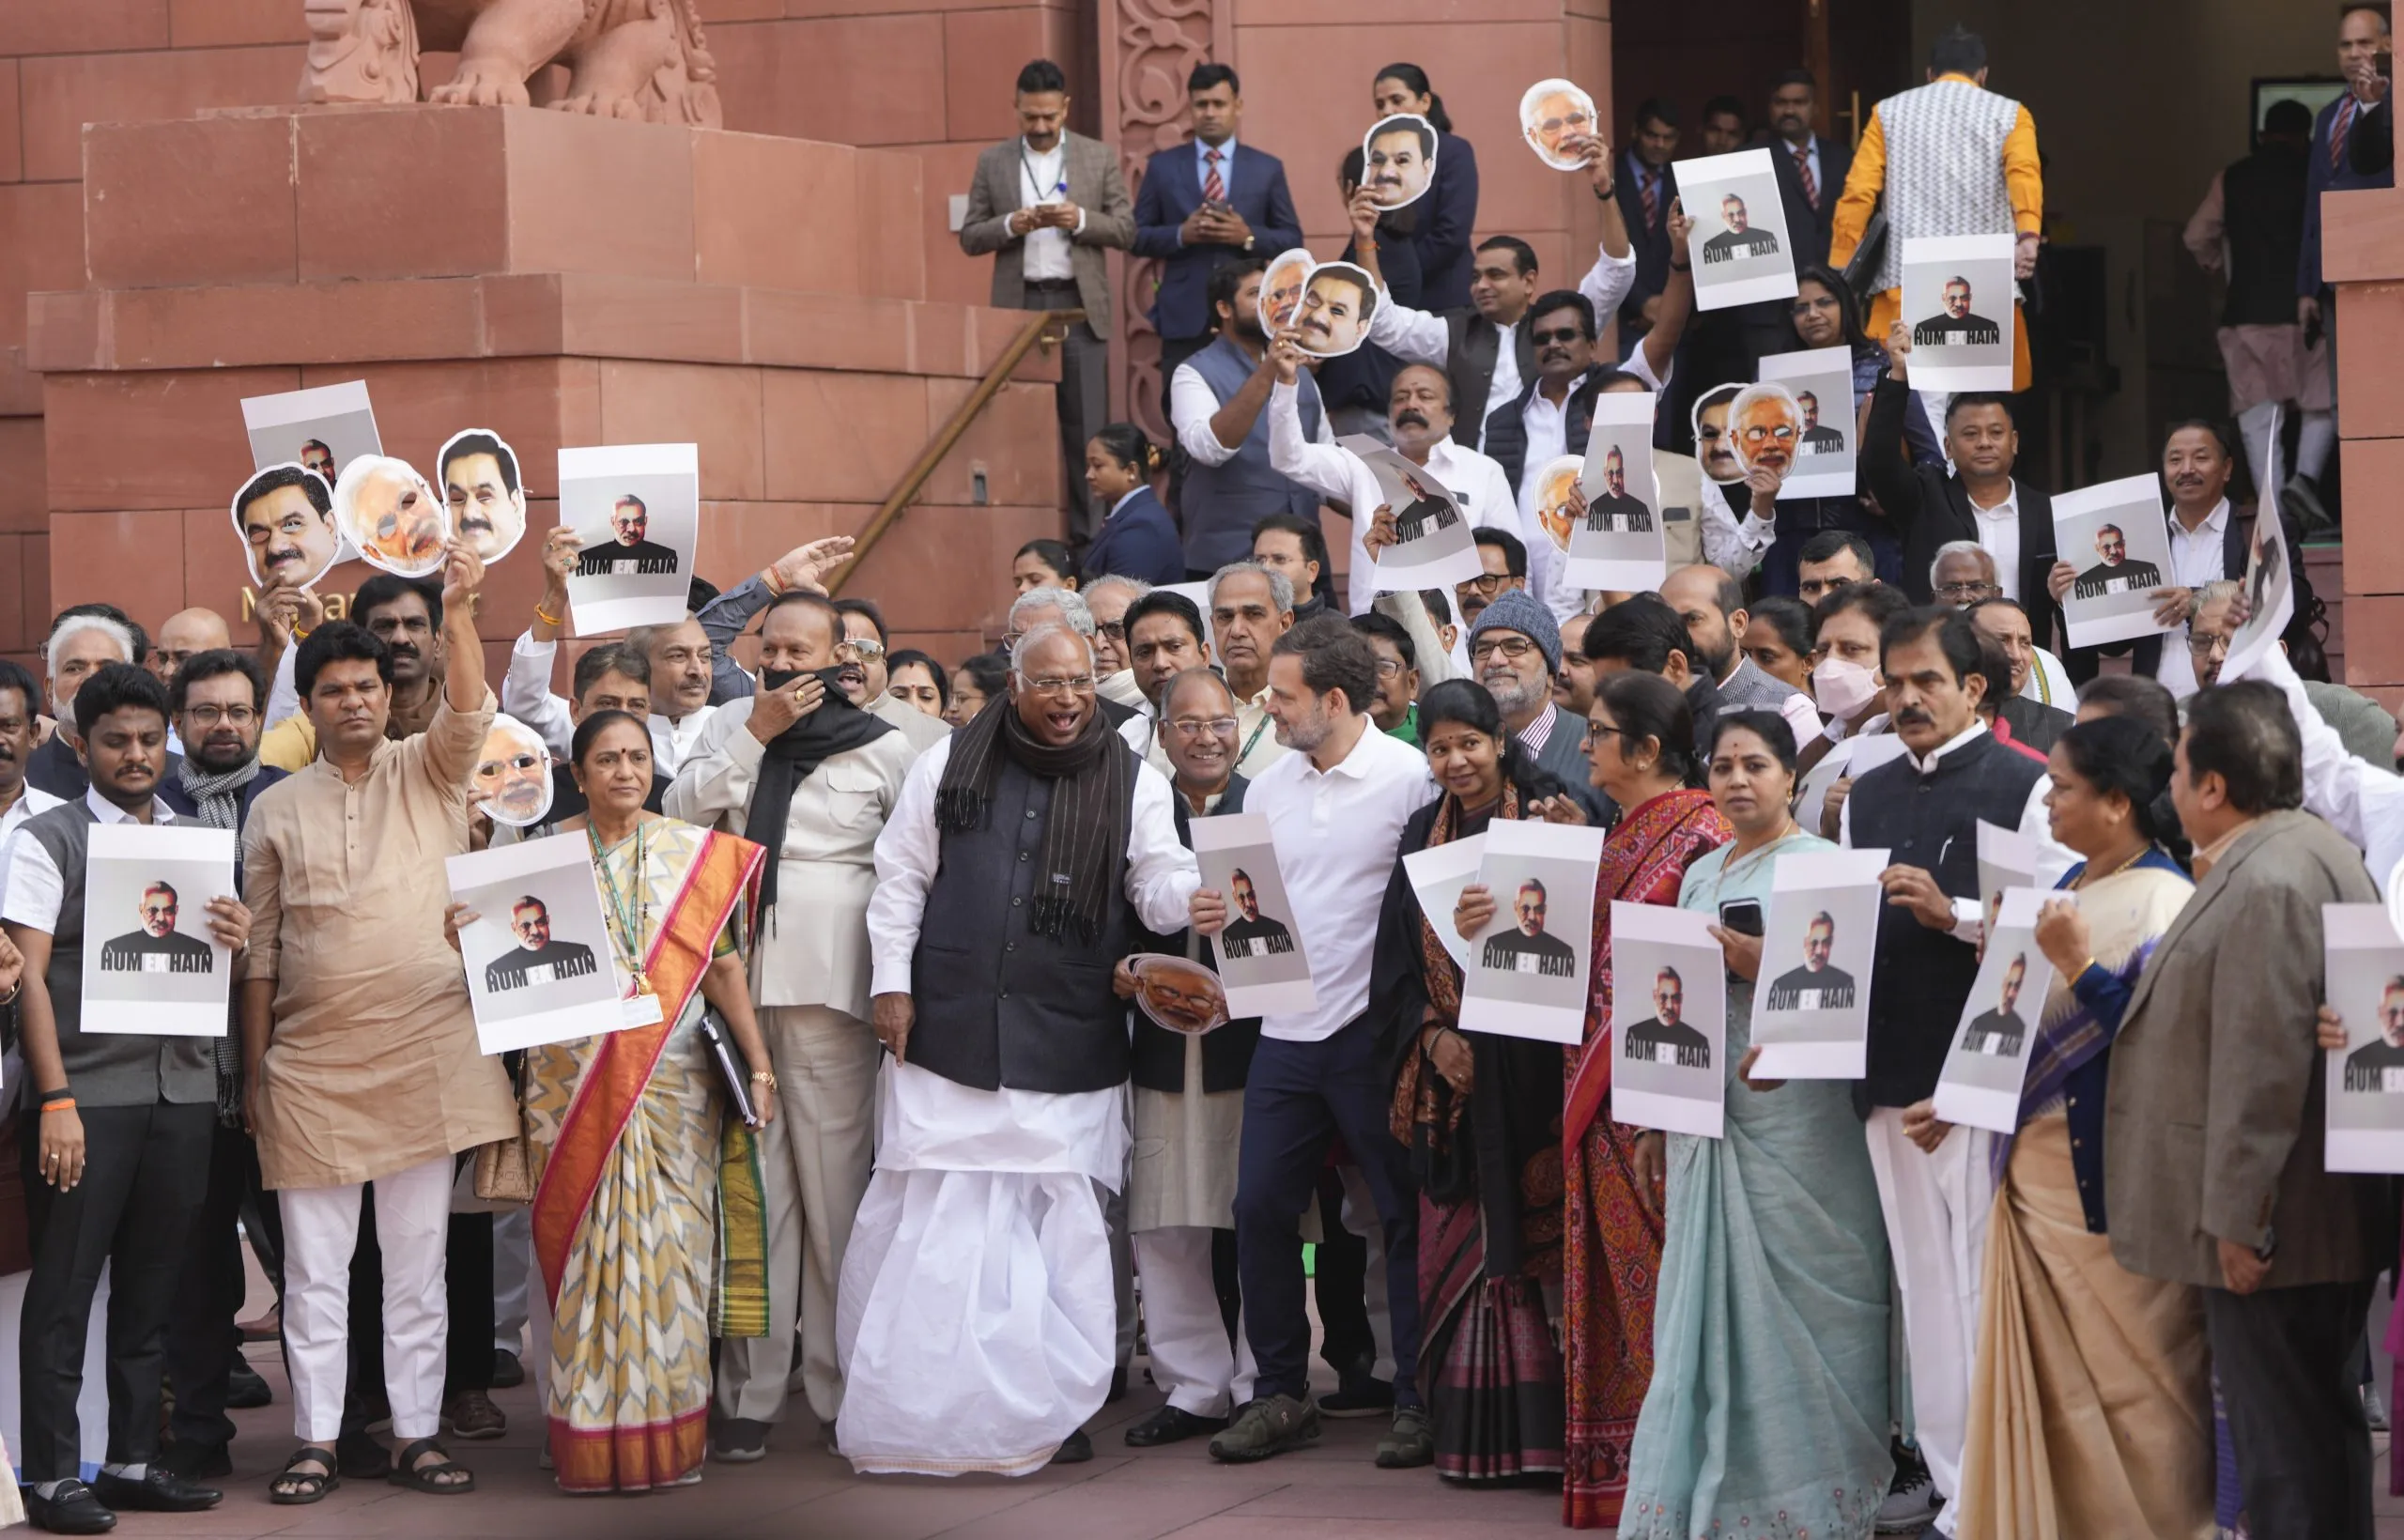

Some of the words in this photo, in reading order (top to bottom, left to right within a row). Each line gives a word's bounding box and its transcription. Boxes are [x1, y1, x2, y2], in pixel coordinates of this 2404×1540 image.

[1703, 246, 1733, 265] HUM
[1750, 240, 1780, 257] HAIN
[1914, 331, 1946, 346] HUM
[1966, 331, 1999, 345] HAIN
[1815, 439, 1844, 454] HAIN
[1396, 520, 1425, 546] HUM
[1436, 507, 1459, 531] HAIN
[1586, 513, 1613, 532] HUM
[1627, 514, 1653, 532] HAIN
[576, 559, 612, 577] HUM
[613, 559, 636, 575] EK
[637, 559, 678, 574] HAIN
[2074, 580, 2107, 601] HUM
[2127, 570, 2162, 591] HAIN
[1223, 938, 1253, 960] HUM
[1265, 933, 1295, 954] HAIN
[100, 951, 142, 971] HUM
[145, 953, 167, 973] EK
[169, 952, 213, 974] HAIN
[485, 968, 529, 993] HUM
[552, 954, 597, 980] HAIN
[1482, 947, 1517, 971] HUM
[1538, 954, 1576, 978] HAIN
[1766, 989, 1800, 1011] HUM
[1820, 987, 1855, 1009] HAIN
[1626, 1037, 1656, 1062] HUM
[1676, 1044, 1710, 1070] HAIN
[2344, 1067, 2382, 1093] HUM
